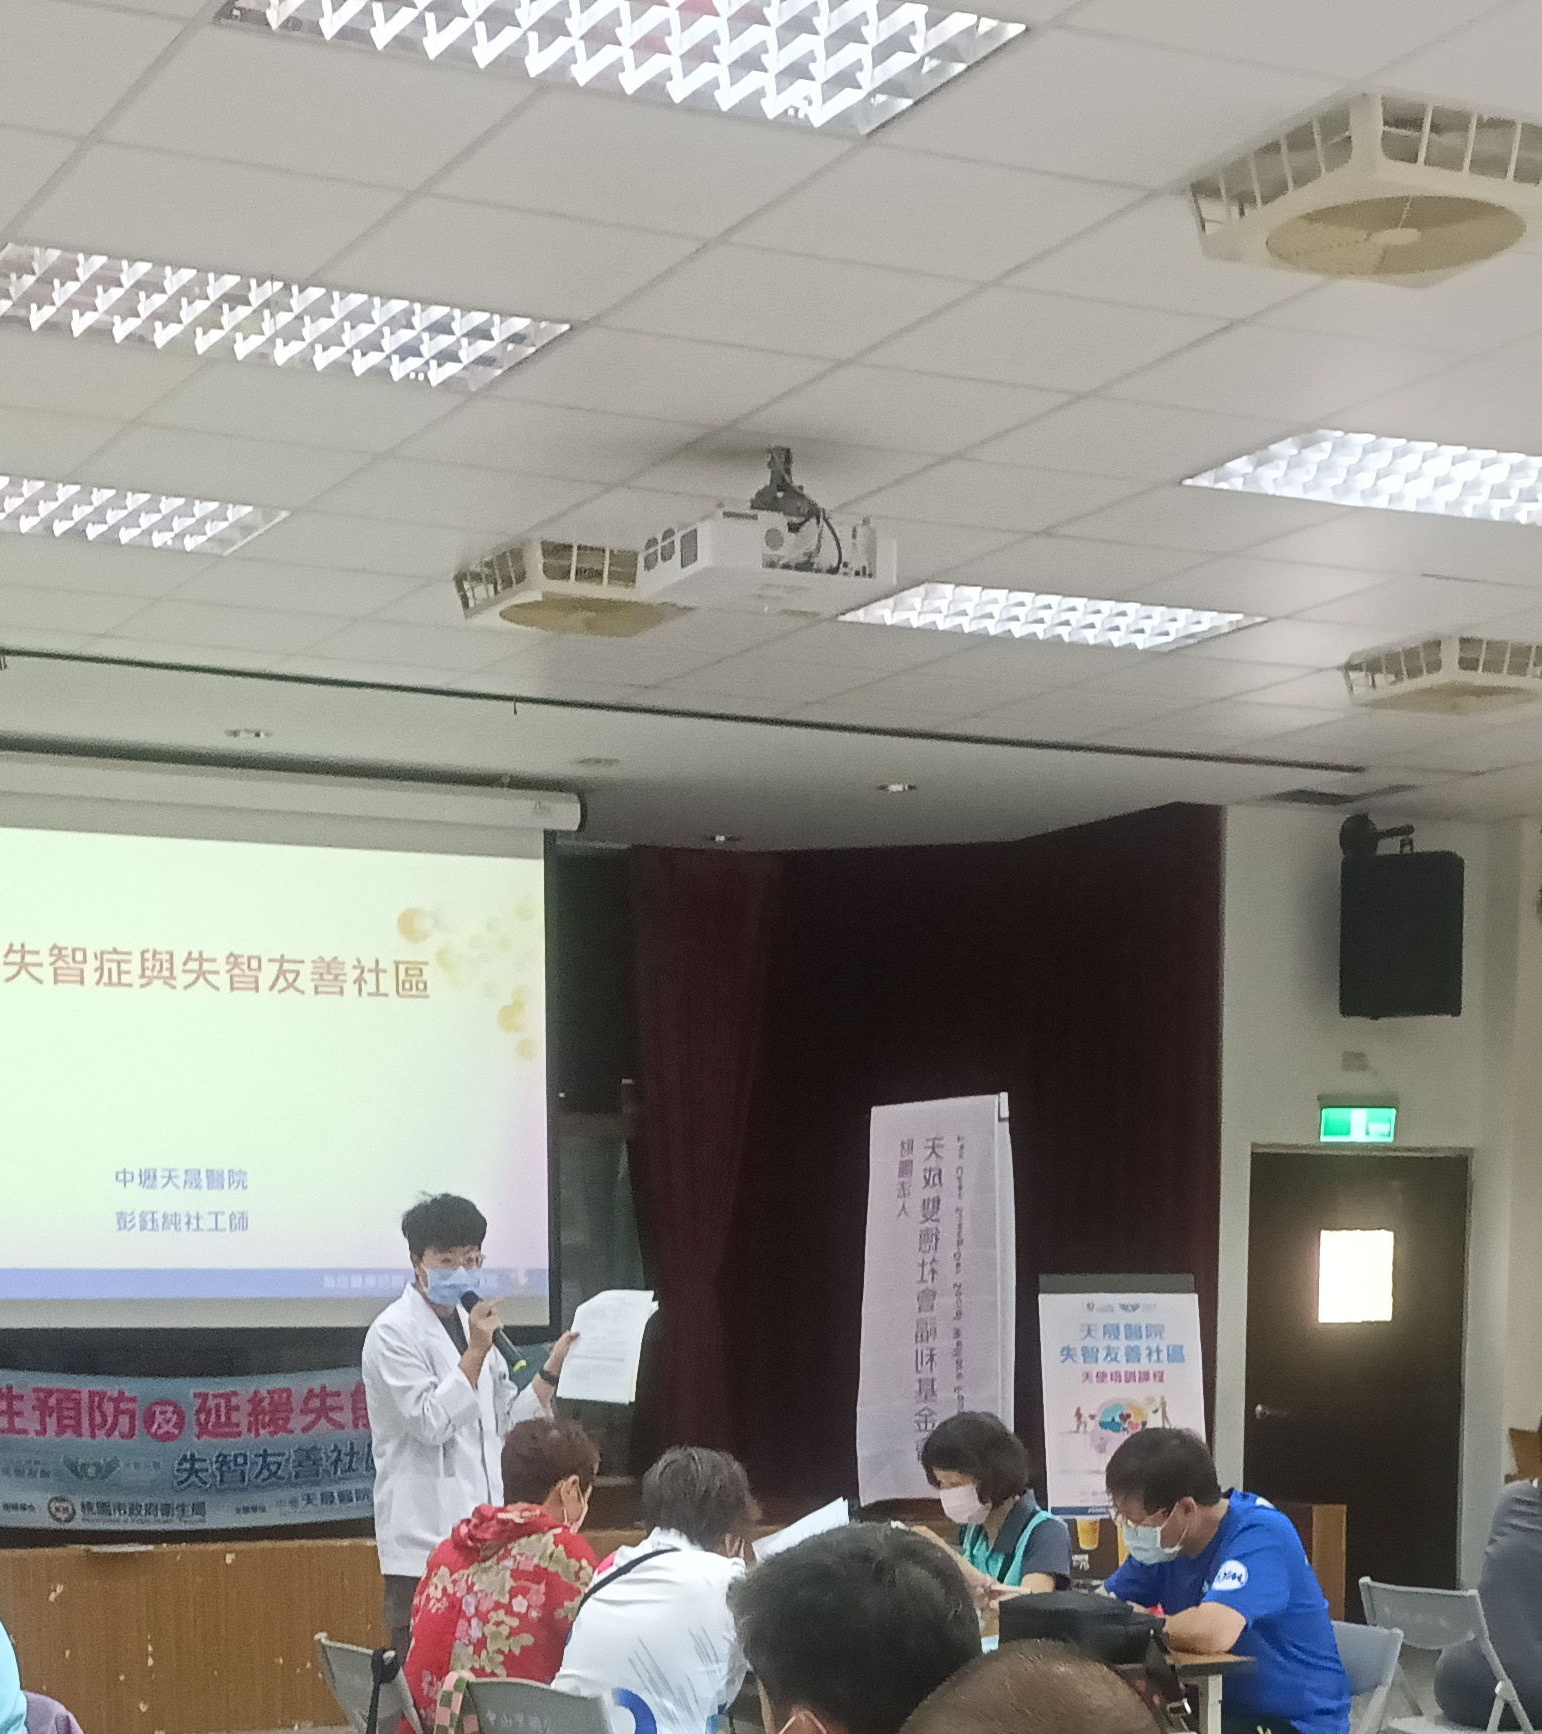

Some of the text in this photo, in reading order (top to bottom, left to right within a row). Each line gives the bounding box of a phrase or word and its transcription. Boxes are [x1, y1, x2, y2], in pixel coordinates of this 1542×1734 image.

[115, 1168, 248, 1190] 中壢天晟醫院
[1060, 1344, 1185, 1364] 失智友善社區
